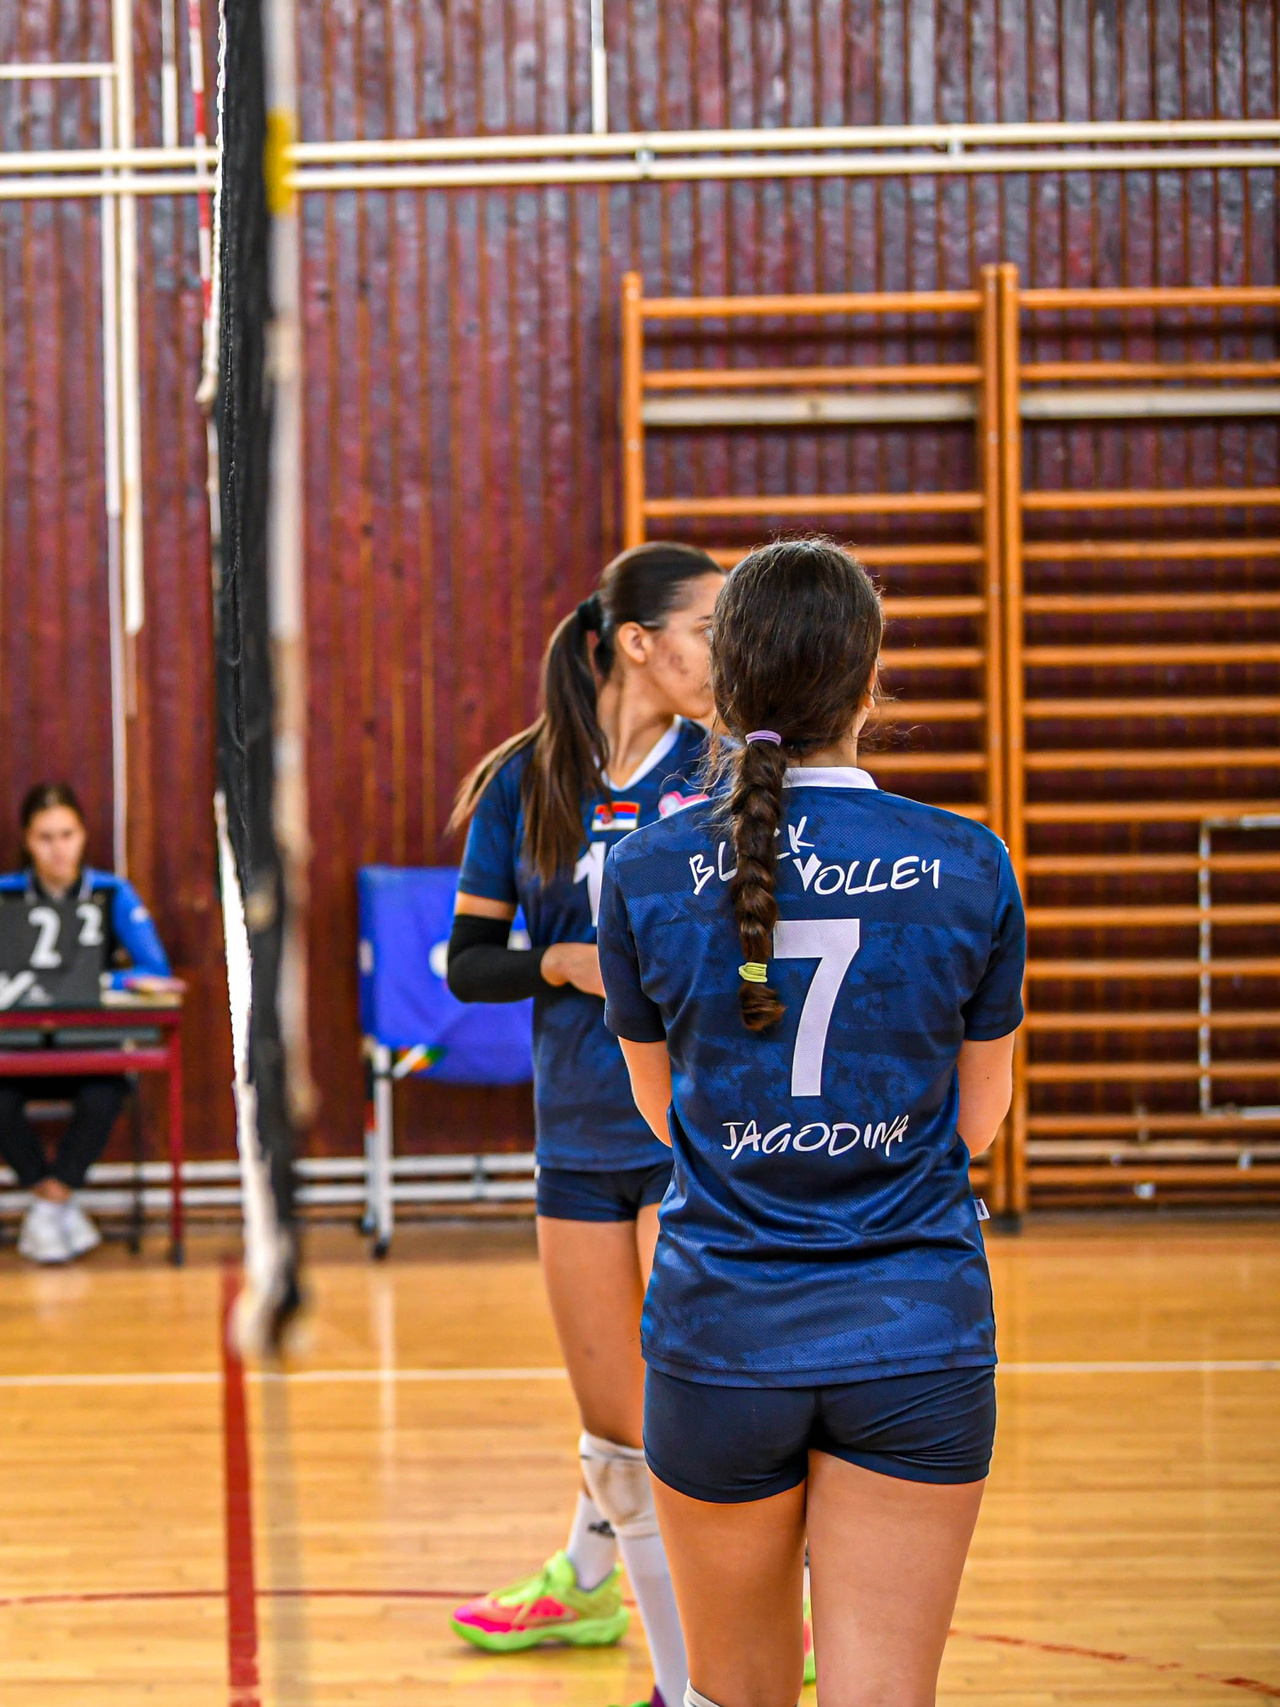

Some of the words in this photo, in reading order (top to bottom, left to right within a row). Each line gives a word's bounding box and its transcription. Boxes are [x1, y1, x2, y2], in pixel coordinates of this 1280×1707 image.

[689, 816, 815, 896] BLK
[793, 852, 941, 895] VOLLEY
[27, 906, 62, 969] 2
[75, 902, 104, 947] 2
[773, 918, 861, 1097] 7
[722, 1114, 910, 1160] JAGODINA
